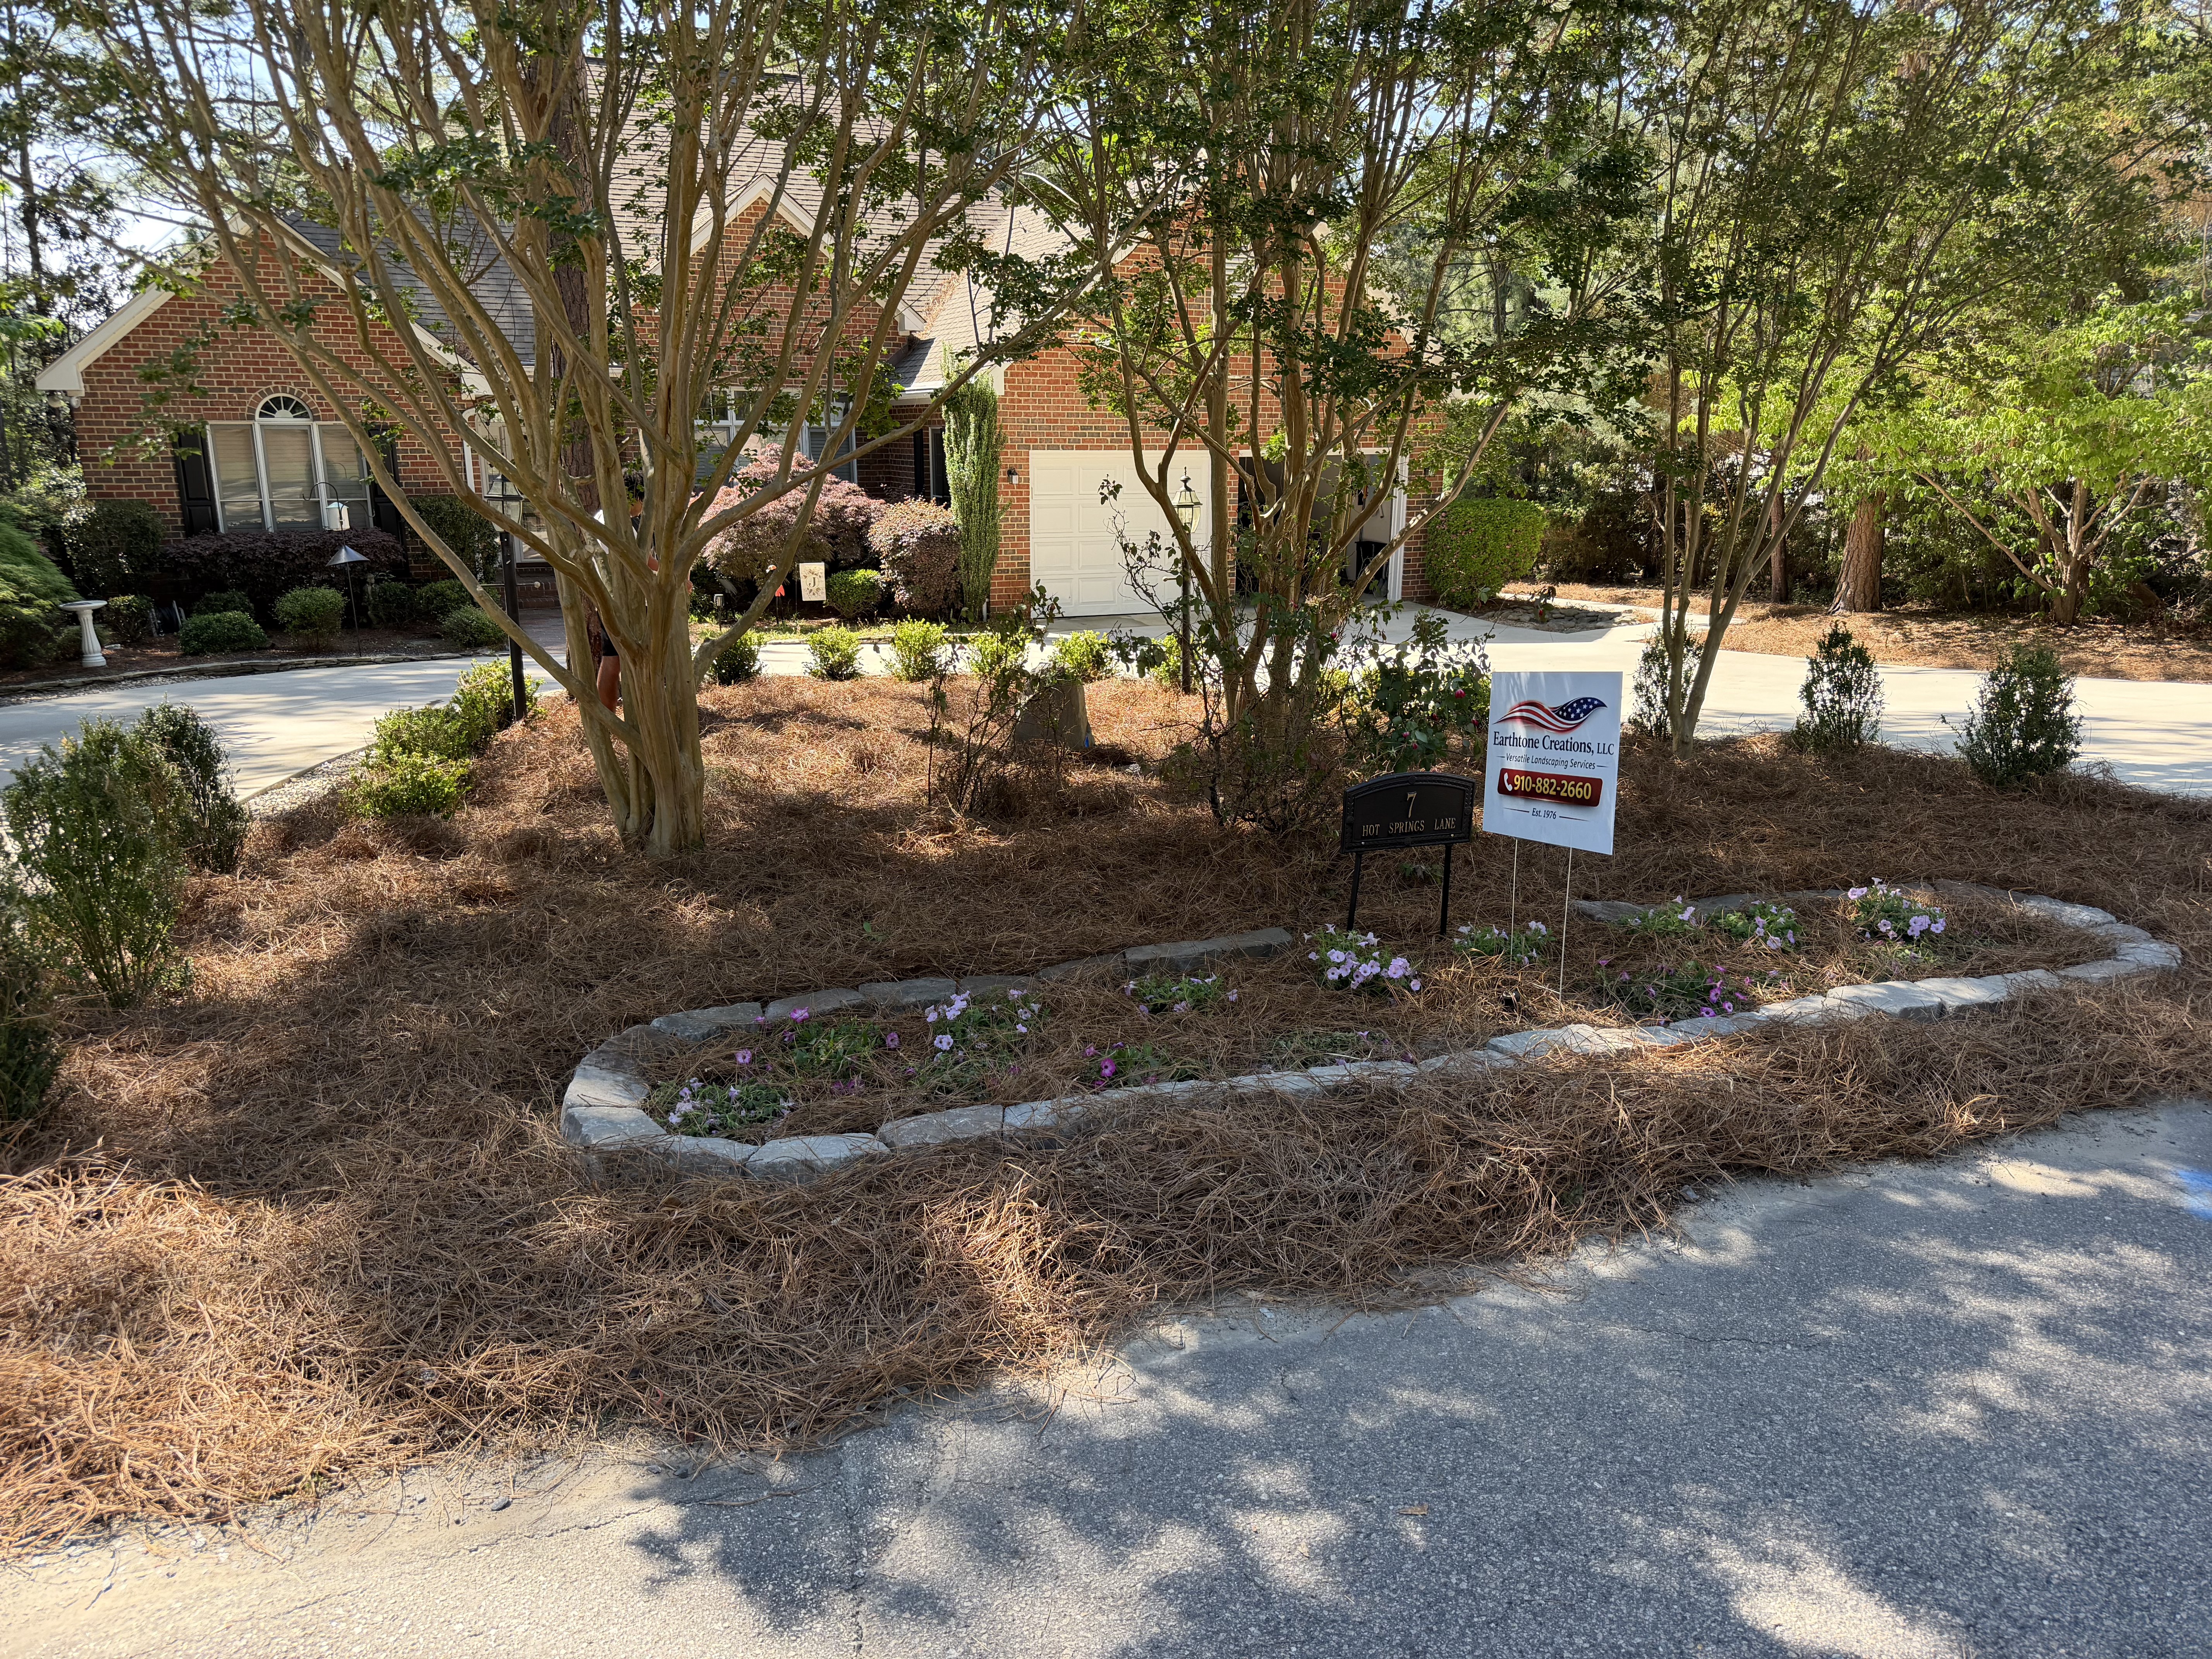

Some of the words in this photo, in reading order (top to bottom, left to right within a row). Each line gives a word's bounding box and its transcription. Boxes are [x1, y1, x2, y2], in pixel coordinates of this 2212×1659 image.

[809, 577, 816, 587] J
[1493, 731, 1539, 749] Earthtone
[1542, 735, 1594, 756] Creations,
[1597, 743, 1614, 755] LLC
[1506, 753, 1530, 764] Versatile
[1531, 756, 1568, 769] Landscaping
[1570, 759, 1595, 769] Services
[1513, 775, 1592, 800] 910-882-2660
[1407, 792, 1417, 818] 7
[1532, 808, 1542, 817] Est.
[1543, 809, 1556, 819] 1976
[1362, 824, 1380, 836] HOT
[1388, 821, 1425, 834] SPRINGS
[1434, 818, 1456, 830] LANE
